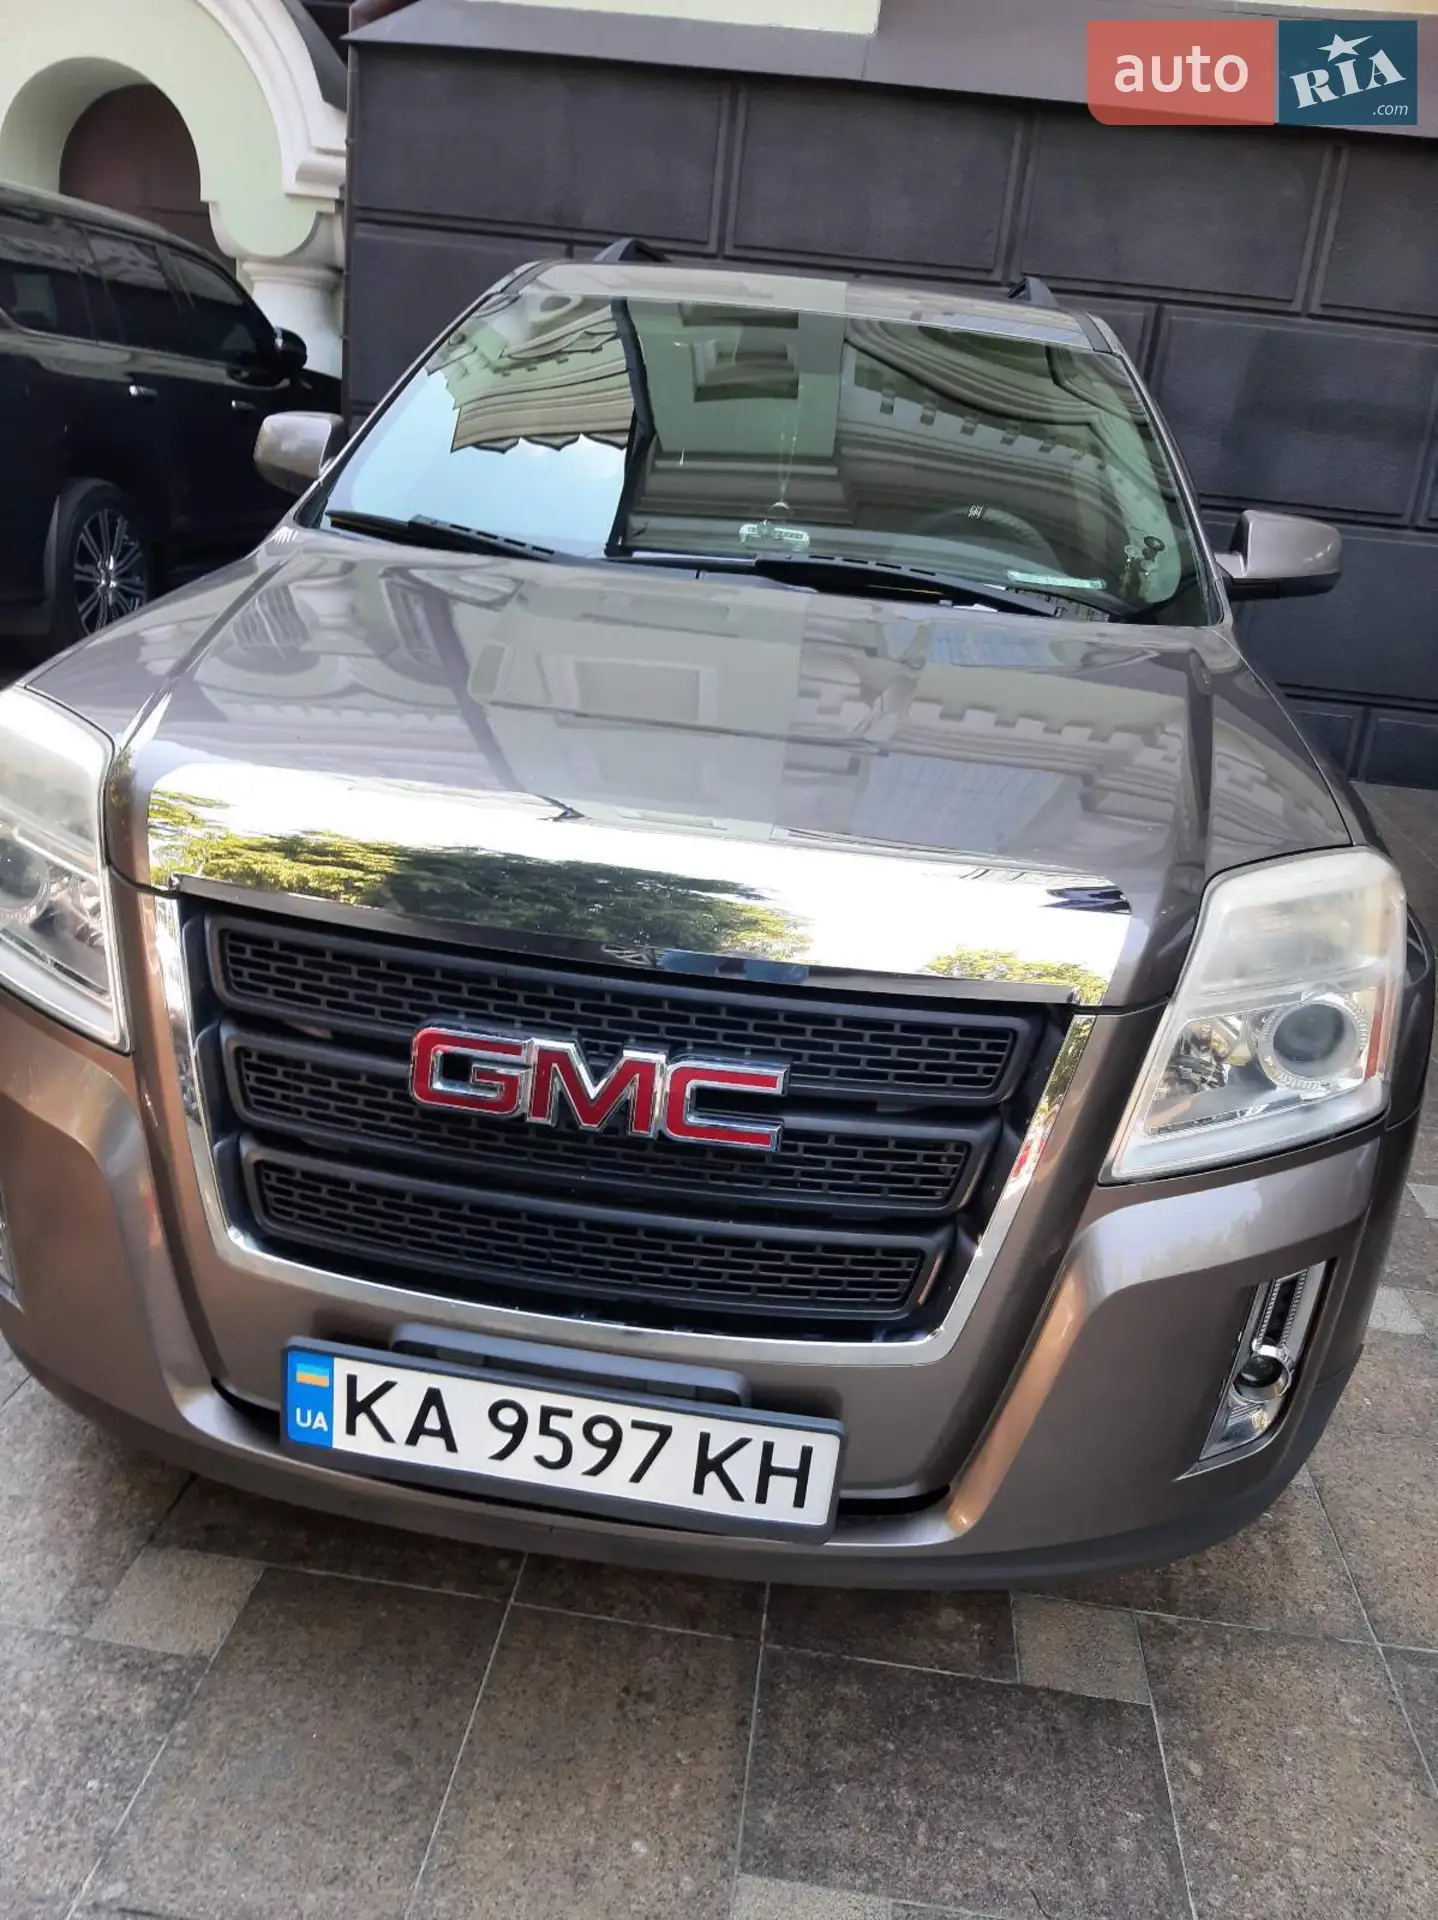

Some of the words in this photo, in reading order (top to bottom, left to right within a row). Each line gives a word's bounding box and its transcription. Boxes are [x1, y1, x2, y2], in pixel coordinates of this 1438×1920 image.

[410, 1023, 789, 1152] GMC
[295, 1408, 329, 1433] UA
[345, 1373, 459, 1453] KA
[486, 1398, 674, 1484] 9597
[692, 1431, 814, 1509] KH
